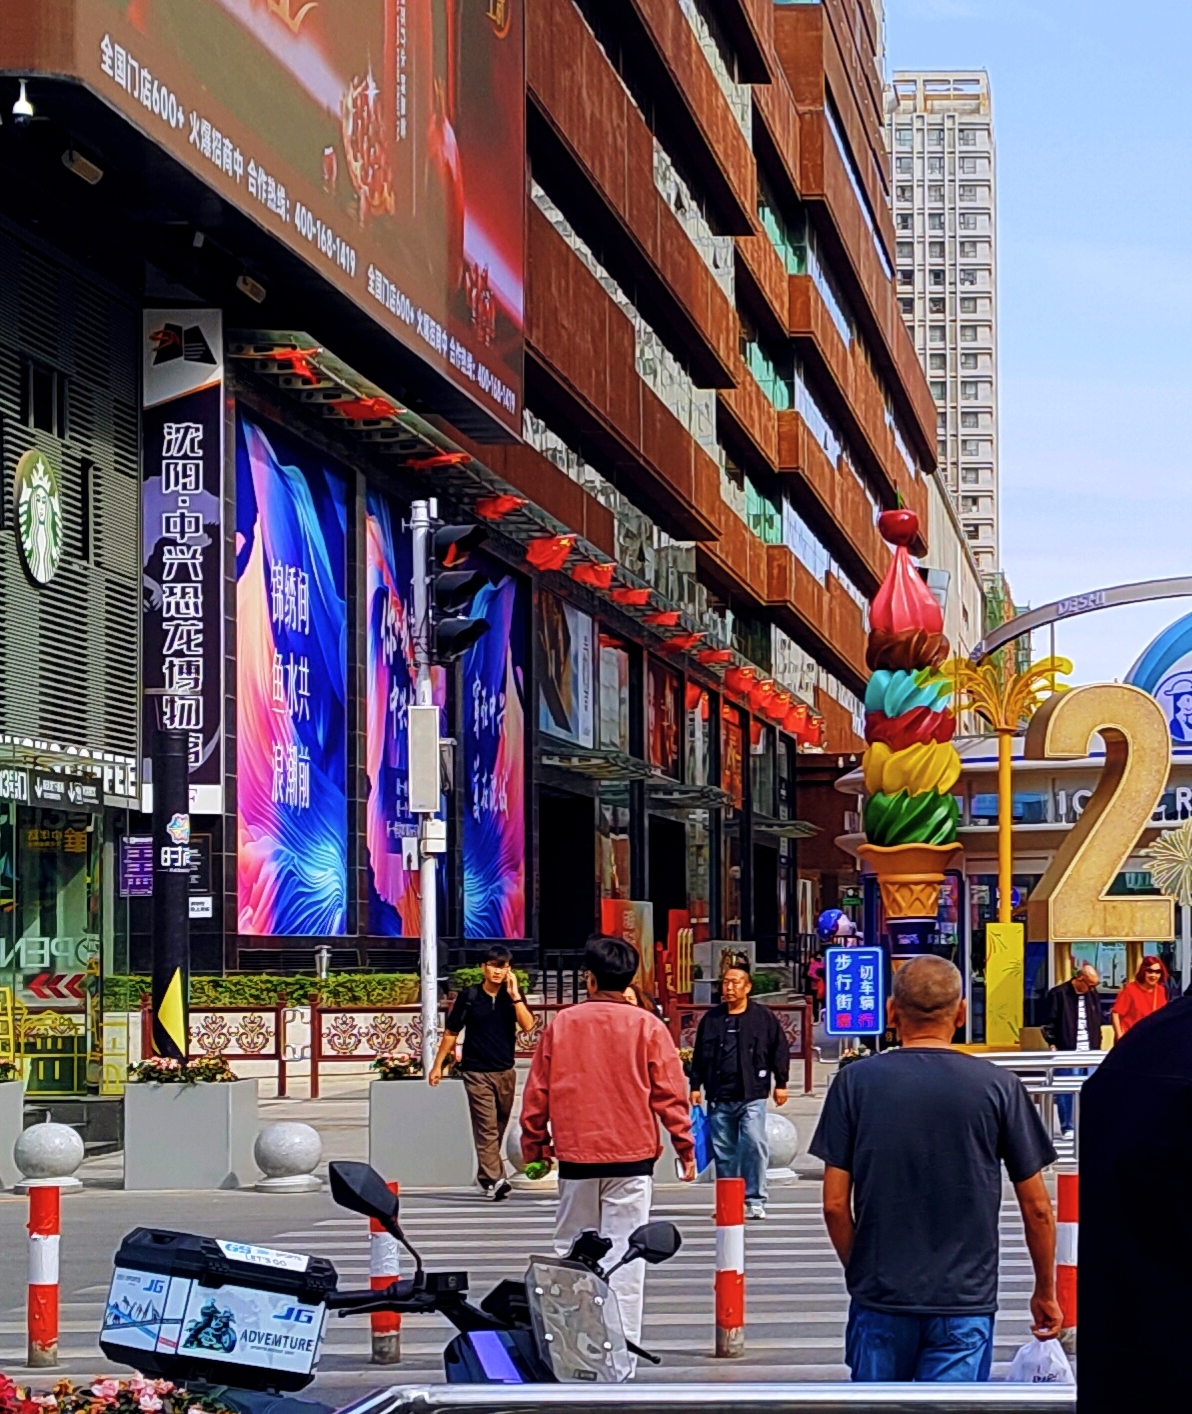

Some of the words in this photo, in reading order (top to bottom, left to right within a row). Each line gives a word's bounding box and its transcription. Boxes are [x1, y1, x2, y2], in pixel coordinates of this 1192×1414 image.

[100, 33, 186, 130] 全国门店600+
[294, 201, 356, 278] 400-168-1419
[270, 647, 311, 723] 鱼水共
[834, 953, 854, 1012] 步行街
[858, 954, 876, 1012] 一切车辆
[271, 1306, 317, 1326] JG
